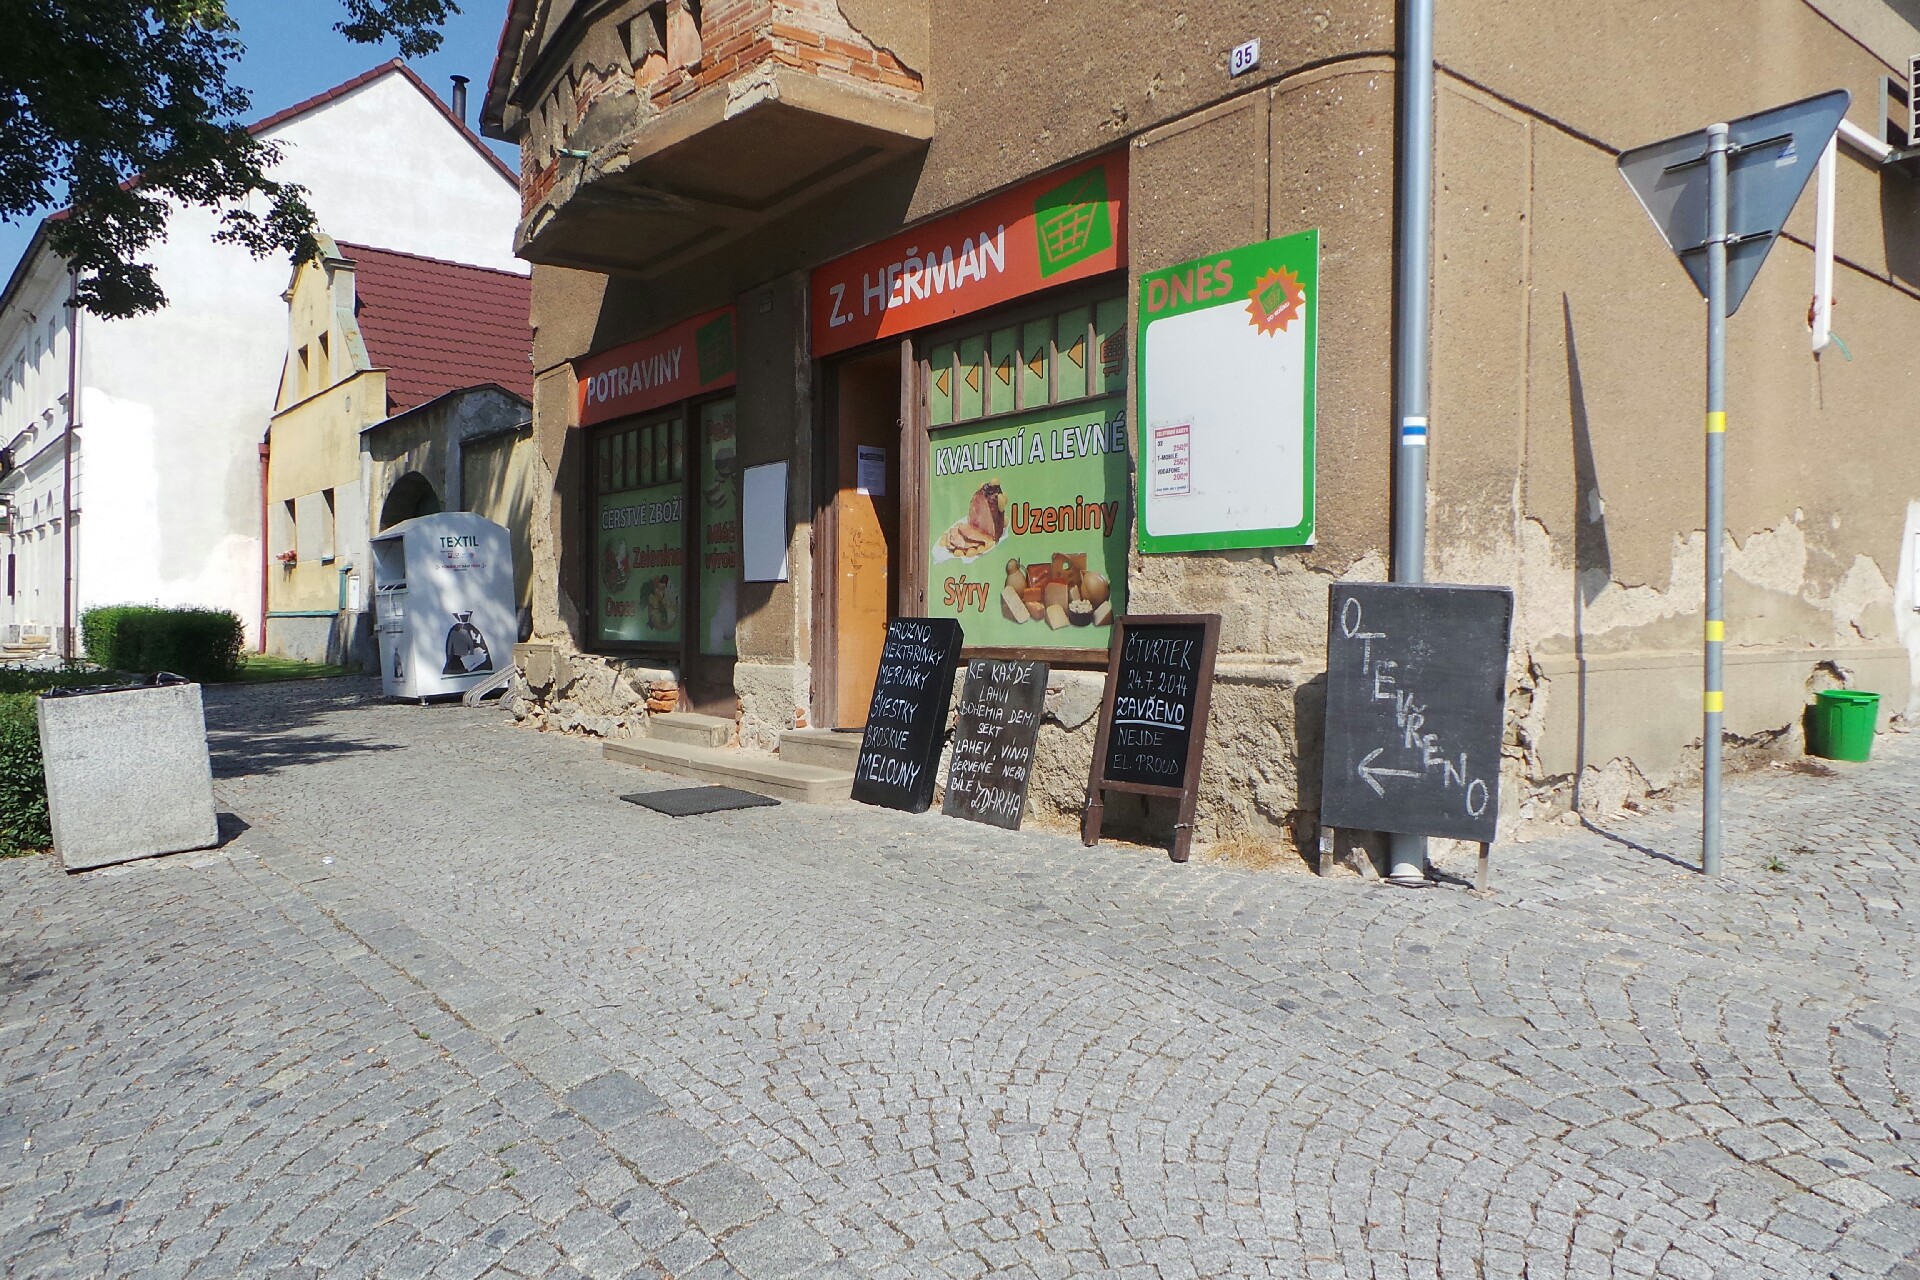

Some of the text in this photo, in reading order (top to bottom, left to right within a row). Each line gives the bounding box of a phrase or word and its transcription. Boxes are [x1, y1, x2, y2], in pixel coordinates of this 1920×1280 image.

[1236, 45, 1252, 68] 35
[829, 224, 1005, 328] Z. HEŘMAN
[1147, 259, 1234, 313] DNES
[587, 345, 682, 406] POTRAVINY
[935, 428, 1025, 476] KVALITNÍ
[1028, 432, 1045, 464] A
[1051, 411, 1126, 460] LEVNÉ
[602, 498, 647, 530] ČERSTVÉ
[1011, 495, 1119, 537] Uzeniny
[439, 535, 479, 548] TEXTIL
[943, 574, 990, 613] Sýry
[1125, 632, 1194, 670] ČTVRTEK
[879, 664, 930, 690] MERUŇKY
[968, 660, 1035, 685] KE KAŽDÉ
[871, 689, 918, 724] ŠVESTKY
[979, 685, 1010, 703] LAHVI
[959, 700, 1035, 728] BOHEMIA DEMI
[1116, 694, 1185, 723] ZAVŘENO
[865, 724, 910, 751] BROSKVE
[977, 722, 1003, 738] SEKT
[1117, 727, 1165, 746] NEJDE
[1001, 737, 1029, 763] VÍNA
[857, 752, 921, 792] MELOUNY
[1002, 764, 1026, 782] NEBO
[1113, 754, 1179, 774] EL. PROUD
[950, 772, 976, 792] BÍLÉ
